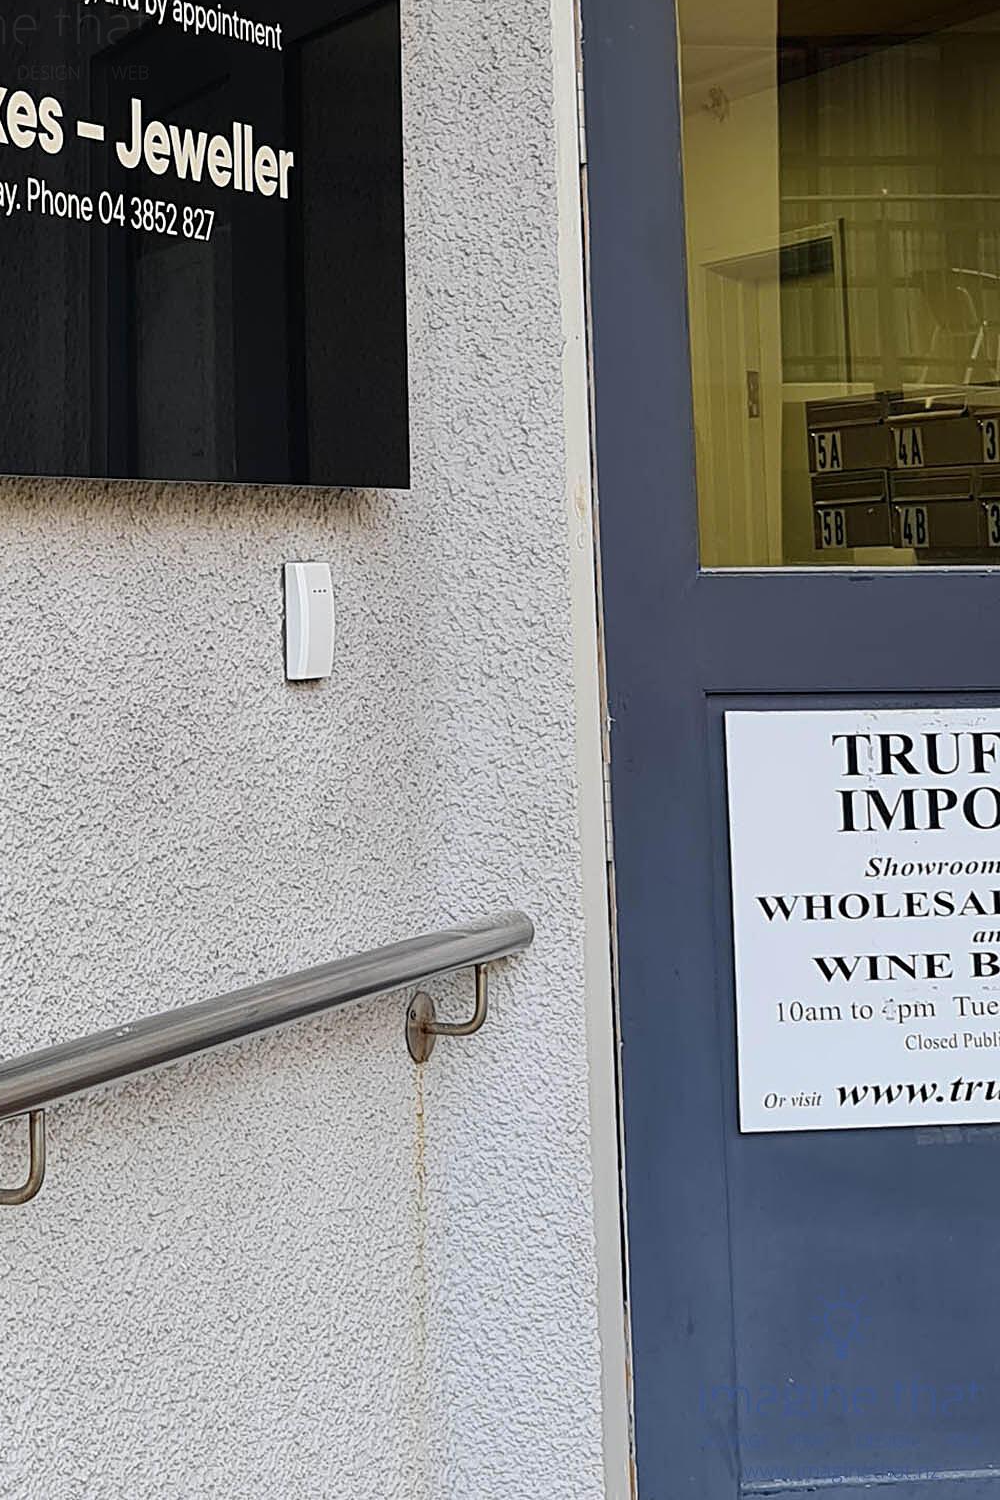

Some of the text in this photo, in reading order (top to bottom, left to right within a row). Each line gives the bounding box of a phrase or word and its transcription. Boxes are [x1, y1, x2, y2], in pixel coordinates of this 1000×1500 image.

[172, 0, 283, 51] appointment
[115, 97, 295, 200] Jeweller
[27, 177, 94, 222] Phone
[98, 190, 126, 227] 04
[130, 196, 178, 236] 3852
[182, 206, 215, 242] 827
[816, 432, 841, 469] 5A
[897, 428, 924, 466] 4A
[823, 510, 844, 546] 5B
[903, 508, 926, 545] 4B
[834, 786, 1000, 833] IMPO
[811, 953, 954, 983] WINE
[776, 1000, 843, 1023] 10am
[851, 1002, 874, 1020] to
[904, 1033, 959, 1051] Closed
[763, 1092, 787, 1109] Or
[790, 1091, 823, 1108] visit
